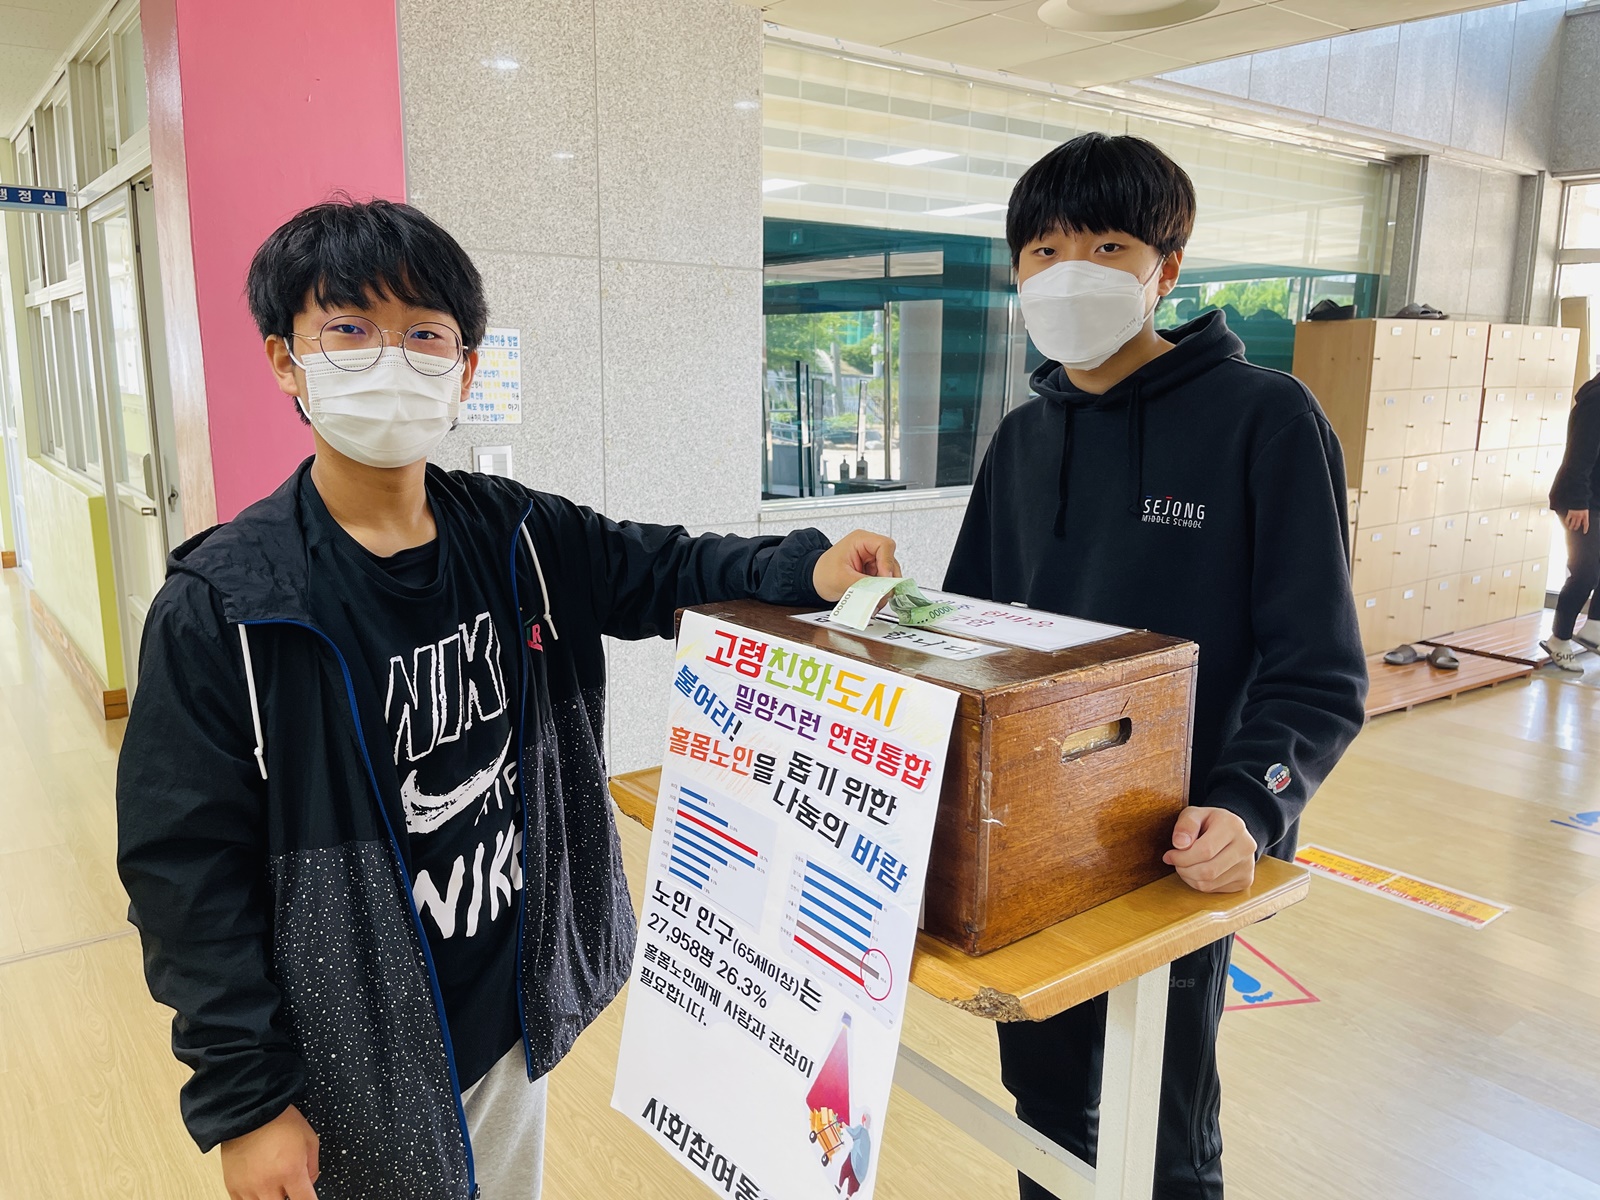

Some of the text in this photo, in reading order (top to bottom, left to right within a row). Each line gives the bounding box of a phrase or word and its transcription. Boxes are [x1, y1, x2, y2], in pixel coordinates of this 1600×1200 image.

[1141, 514, 1202, 529] MIDDLE SCHOOL
[1142, 499, 1206, 520] SEJONG
[384, 611, 509, 766] NIK
[673, 664, 743, 742] 불어라!
[705, 629, 906, 728] 고령친화도시
[669, 726, 898, 826] 홀몸노인을 돕기 위한
[734, 683, 933, 790] 밀양스런 연령통합
[773, 781, 908, 894] 나눔의 바람
[651, 880, 693, 920] 노인
[638, 965, 709, 1027] 필요합니다.
[643, 941, 815, 1079] 홀몸노인에게 사랑과 관심이
[646, 911, 716, 968] 27,958명
[715, 958, 769, 1010] 26.3%
[641, 1097, 769, 1200] 사회참여동
